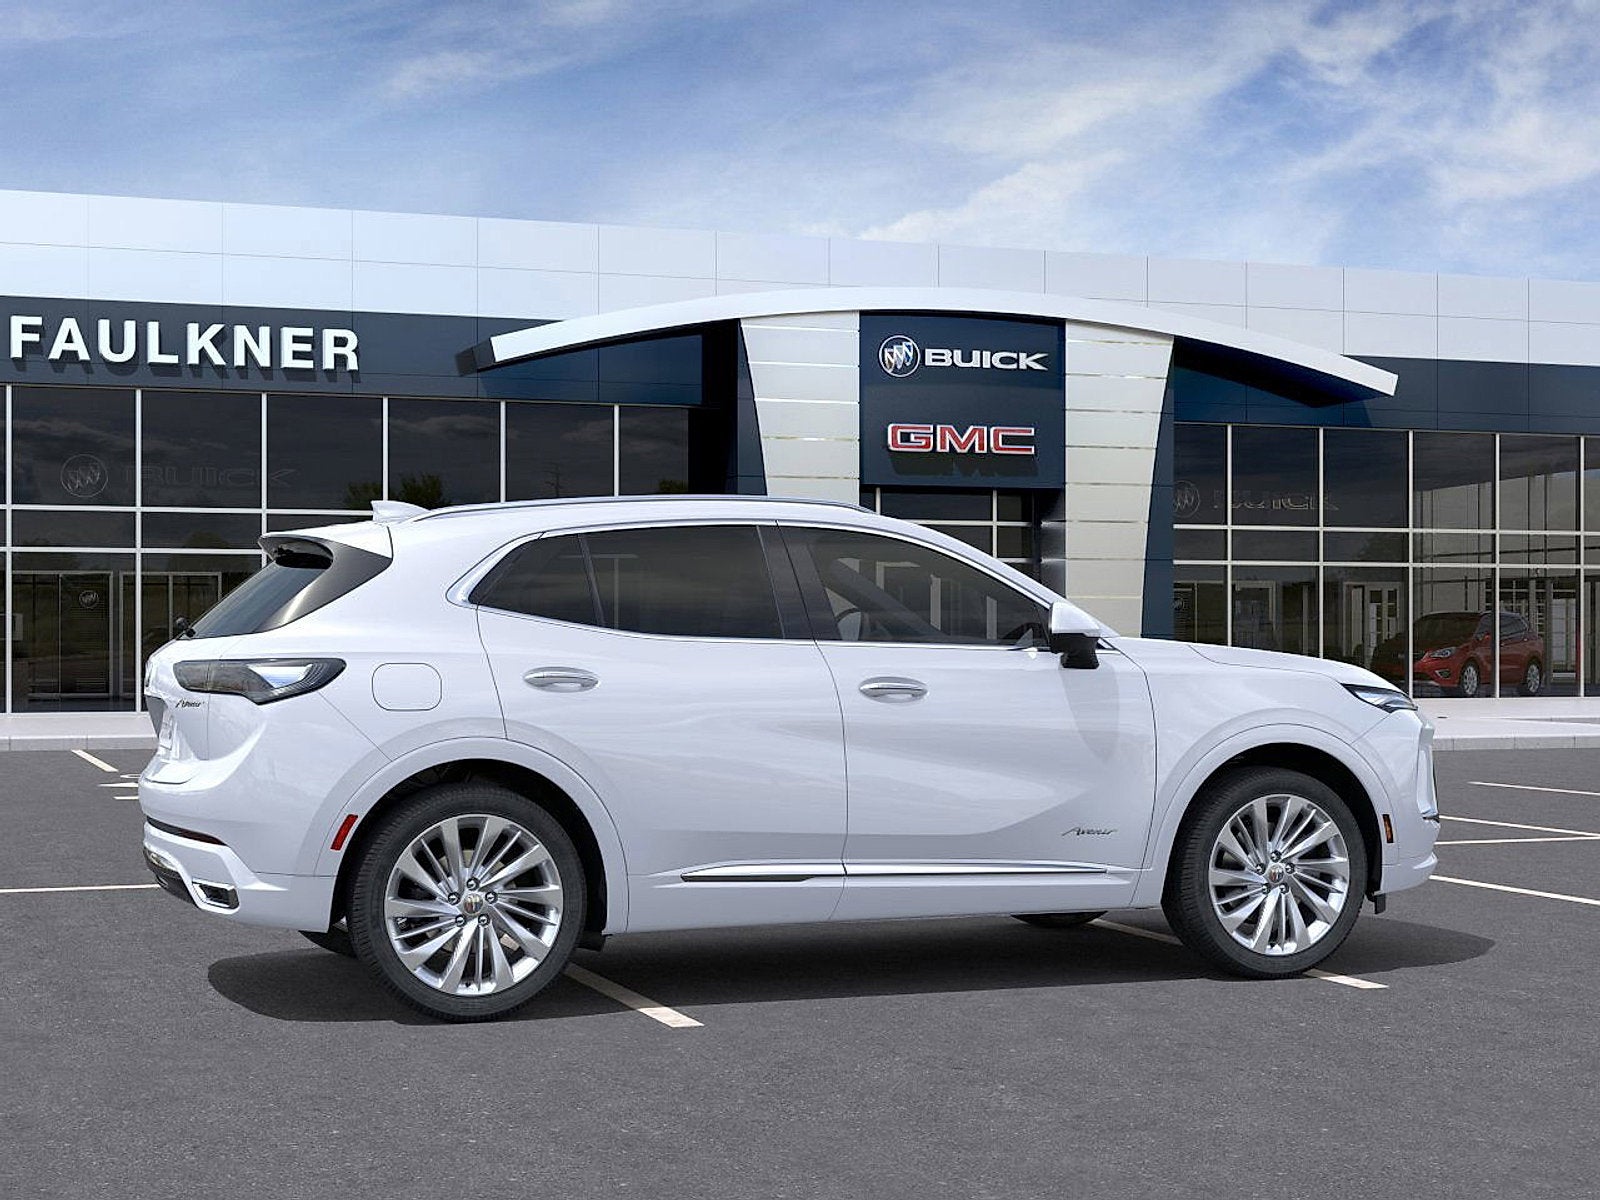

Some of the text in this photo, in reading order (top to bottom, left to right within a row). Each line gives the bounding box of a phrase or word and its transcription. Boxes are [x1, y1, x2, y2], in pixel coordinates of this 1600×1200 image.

[10, 315, 359, 371] FAULKNER
[924, 348, 1049, 371] BUICK
[888, 423, 1035, 455] GMC
